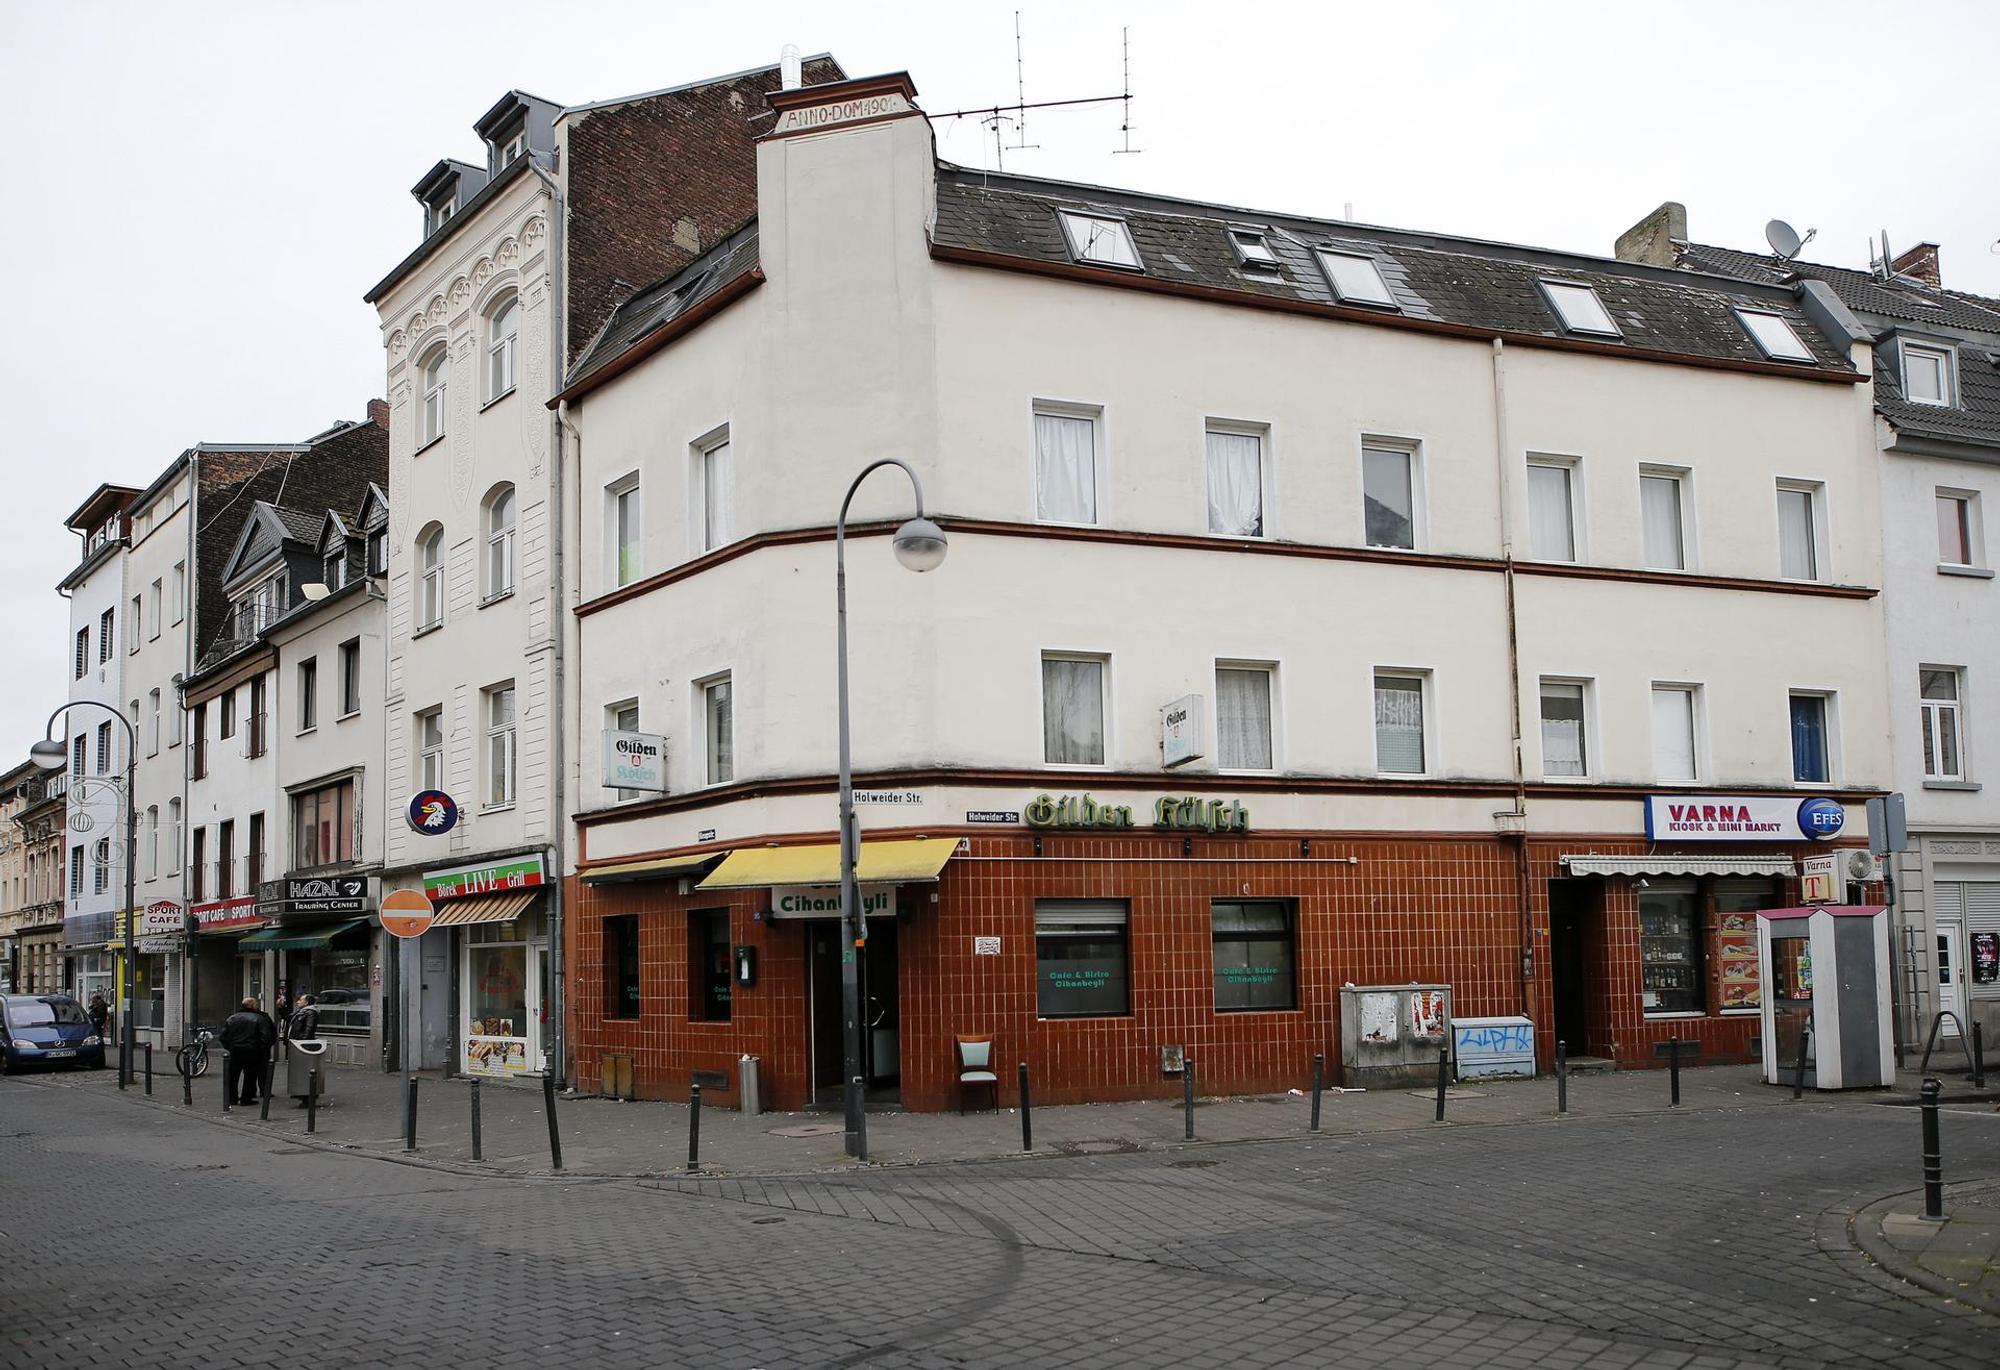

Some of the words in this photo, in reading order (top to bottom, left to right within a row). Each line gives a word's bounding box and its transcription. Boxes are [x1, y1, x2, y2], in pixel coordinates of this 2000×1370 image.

[616, 739, 657, 756] Gilden
[854, 791, 903, 804] Holweider
[906, 792, 923, 804] Str.
[968, 812, 1004, 822] Holweider
[1024, 792, 1136, 828] Gilden
[1153, 794, 1252, 834] Kölsch
[1668, 804, 1752, 822] VARNA
[1812, 811, 1842, 826] EFES
[1669, 822, 1704, 832] KIOSK
[1707, 823, 1715, 832] &
[1718, 823, 1742, 832] MINI
[1745, 823, 1782, 832] MARKT
[1806, 861, 1832, 871] Varna
[290, 879, 340, 898] HAZAL
[437, 881, 458, 897] Börek
[463, 868, 499, 894] LIVE
[506, 869, 525, 889] Grill
[1805, 877, 1821, 899] T
[147, 906, 182, 915] SPORT
[780, 892, 888, 915] Cihanyli
[149, 914, 181, 924] CAFÉ
[210, 905, 225, 922] CAFÉ
[231, 904, 251, 920] SPORT
